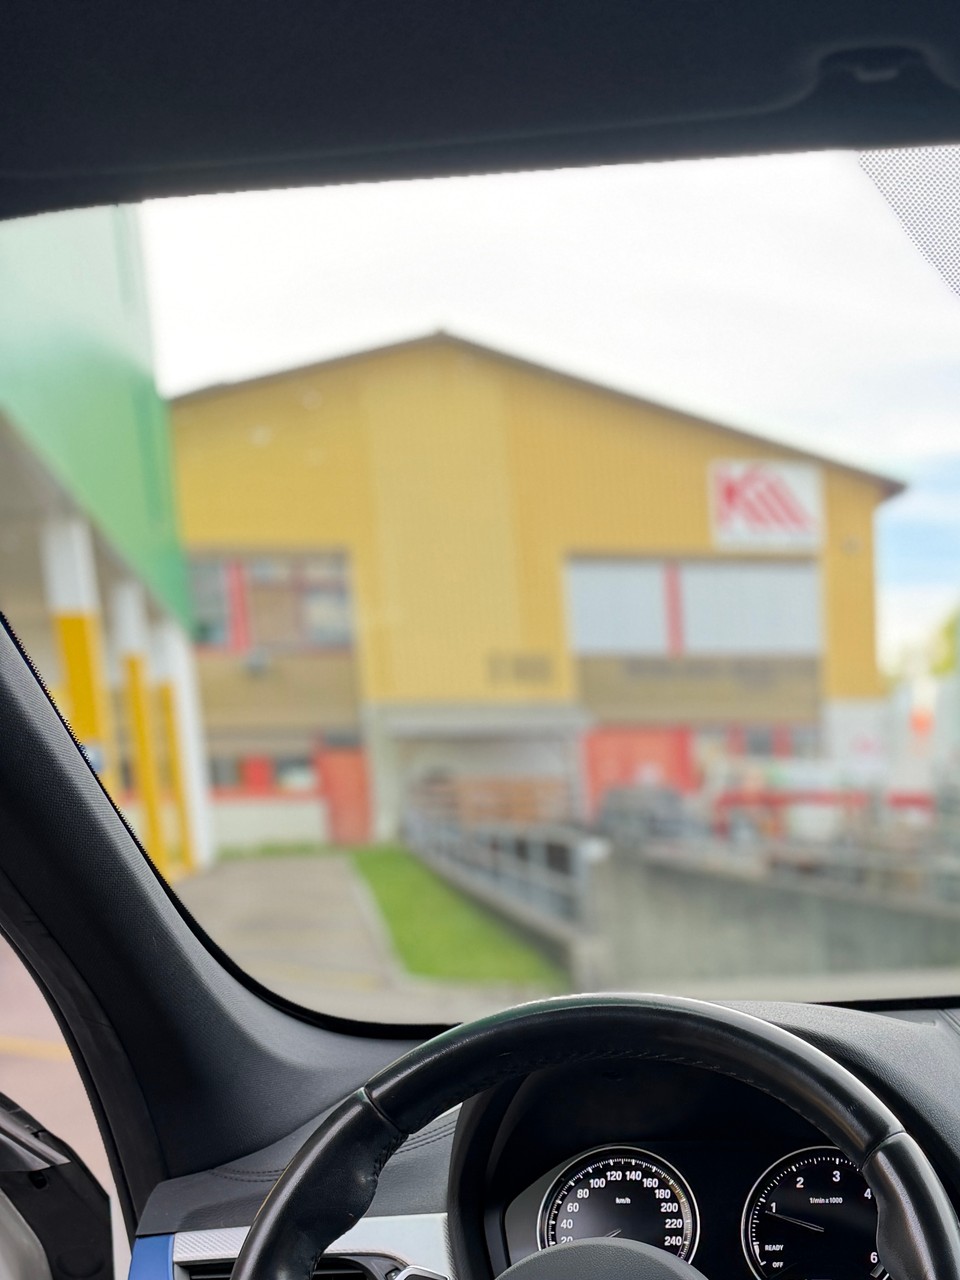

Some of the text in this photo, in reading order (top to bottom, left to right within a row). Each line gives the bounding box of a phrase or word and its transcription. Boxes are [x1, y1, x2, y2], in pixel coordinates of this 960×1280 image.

[606, 1171, 622, 1181] 120
[625, 1171, 642, 1181] 140
[832, 1171, 841, 1182] 3
[589, 1178, 606, 1188] 100
[642, 1178, 659, 1188] 160
[796, 1177, 804, 1188] 2
[577, 1189, 589, 1199] 80
[655, 1189, 671, 1199] 180
[864, 1188, 872, 1200] 4
[567, 1203, 579, 1213] 60
[660, 1203, 679, 1213] 200
[770, 1202, 777, 1213] 1
[560, 1219, 573, 1229] 40
[665, 1219, 683, 1229] 220
[664, 1236, 682, 1246] 240
[870, 1252, 878, 1264] 6
